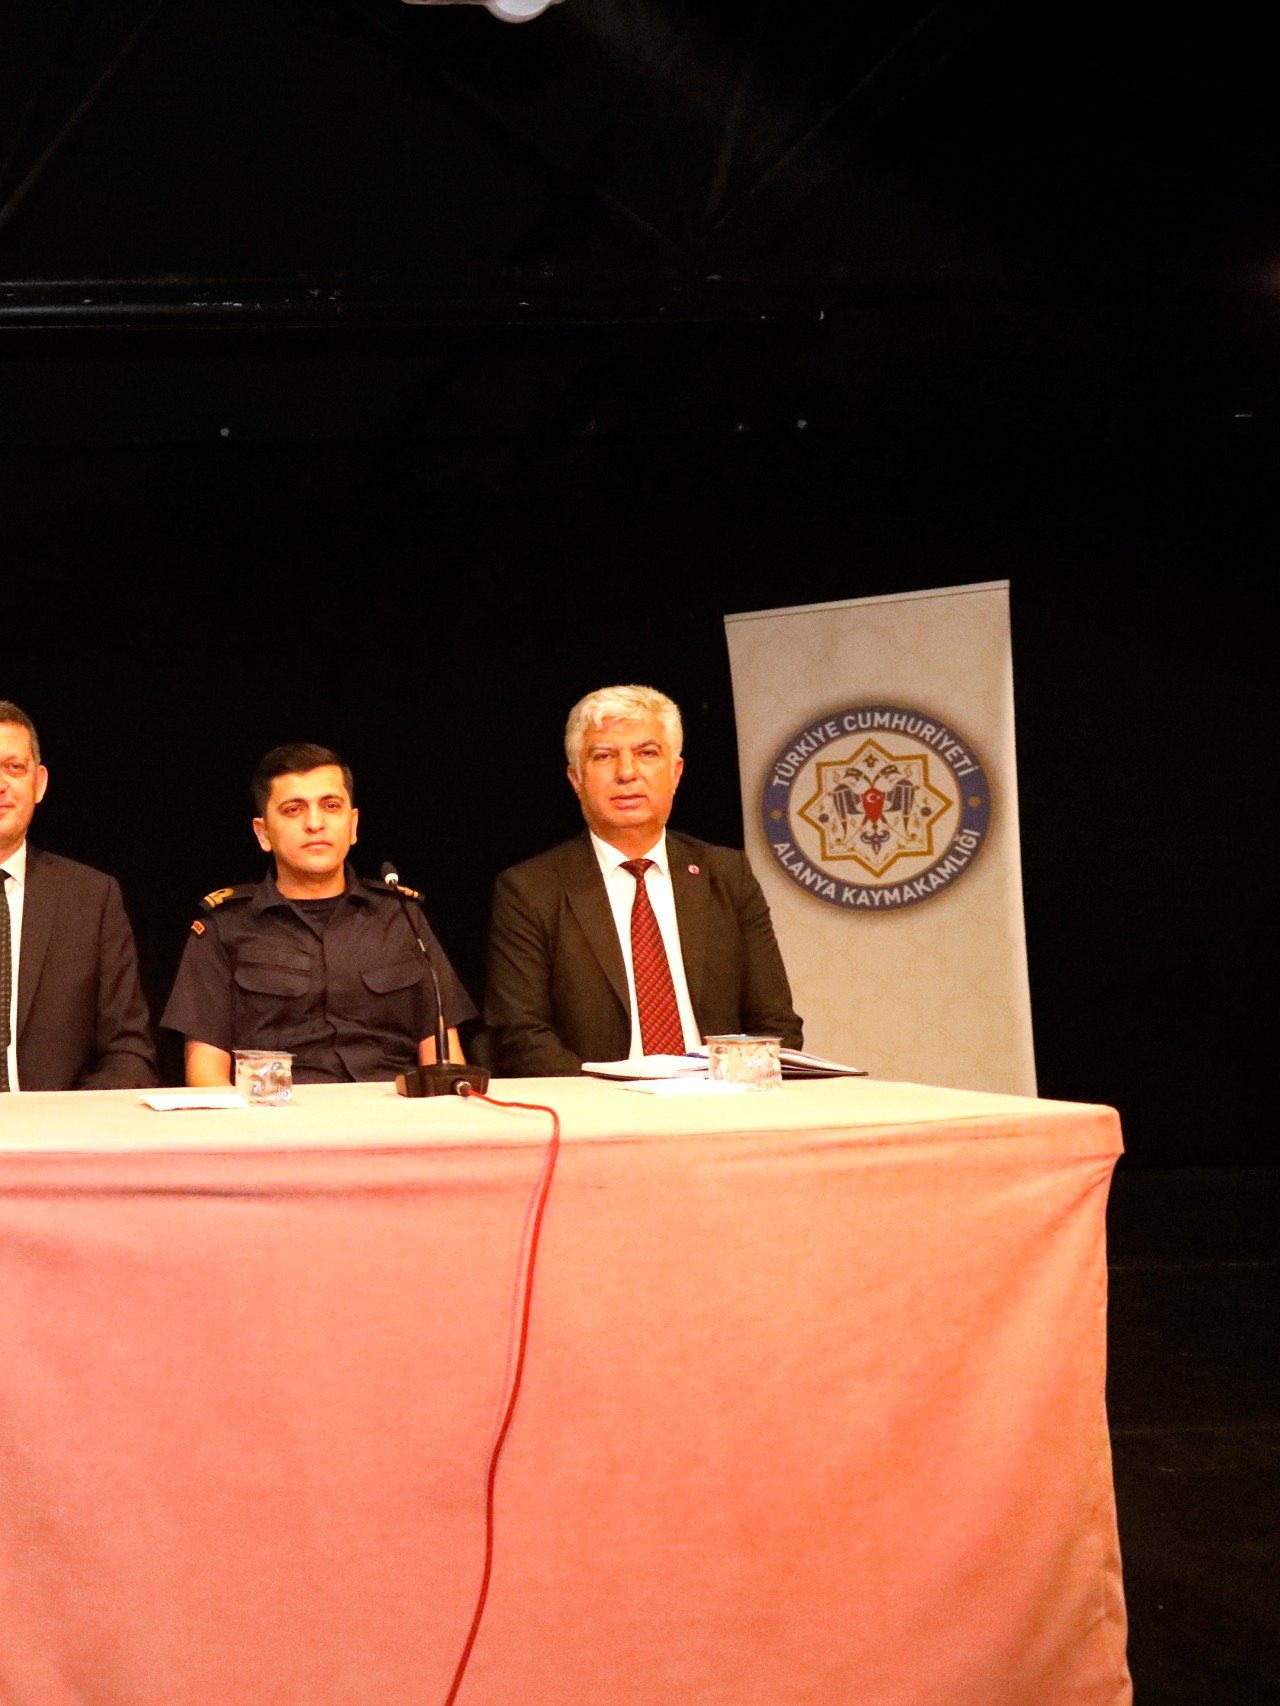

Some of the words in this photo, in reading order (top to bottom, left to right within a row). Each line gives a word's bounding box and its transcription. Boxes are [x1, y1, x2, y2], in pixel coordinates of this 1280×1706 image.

[772, 720, 841, 787] TÜRKİYE
[843, 712, 980, 777] CUMHURİYETİ
[773, 842, 835, 899] ALANYA
[842, 829, 981, 906] KAYMAKAMLIĞI
